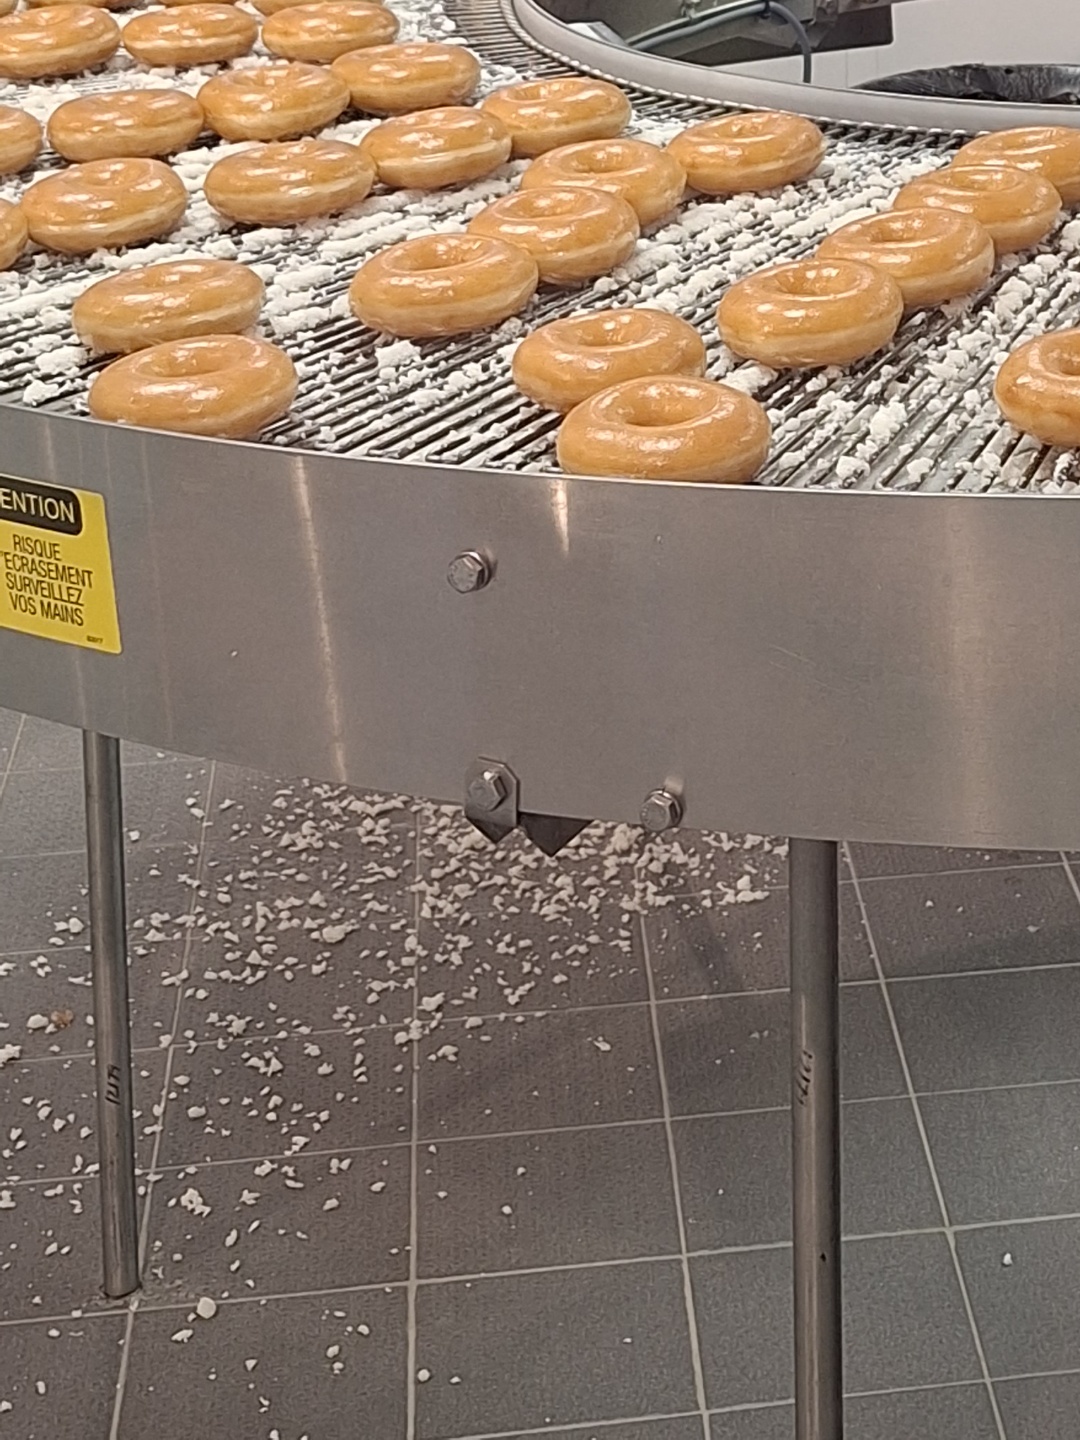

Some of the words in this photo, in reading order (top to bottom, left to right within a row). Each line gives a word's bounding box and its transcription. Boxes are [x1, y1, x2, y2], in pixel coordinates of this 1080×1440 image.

[0, 487, 75, 524] ENTION
[13, 534, 62, 561] RISQUE
[5, 572, 85, 607] SURVEILLEZ
[9, 591, 37, 616] VOS
[40, 599, 84, 627] MAINS
